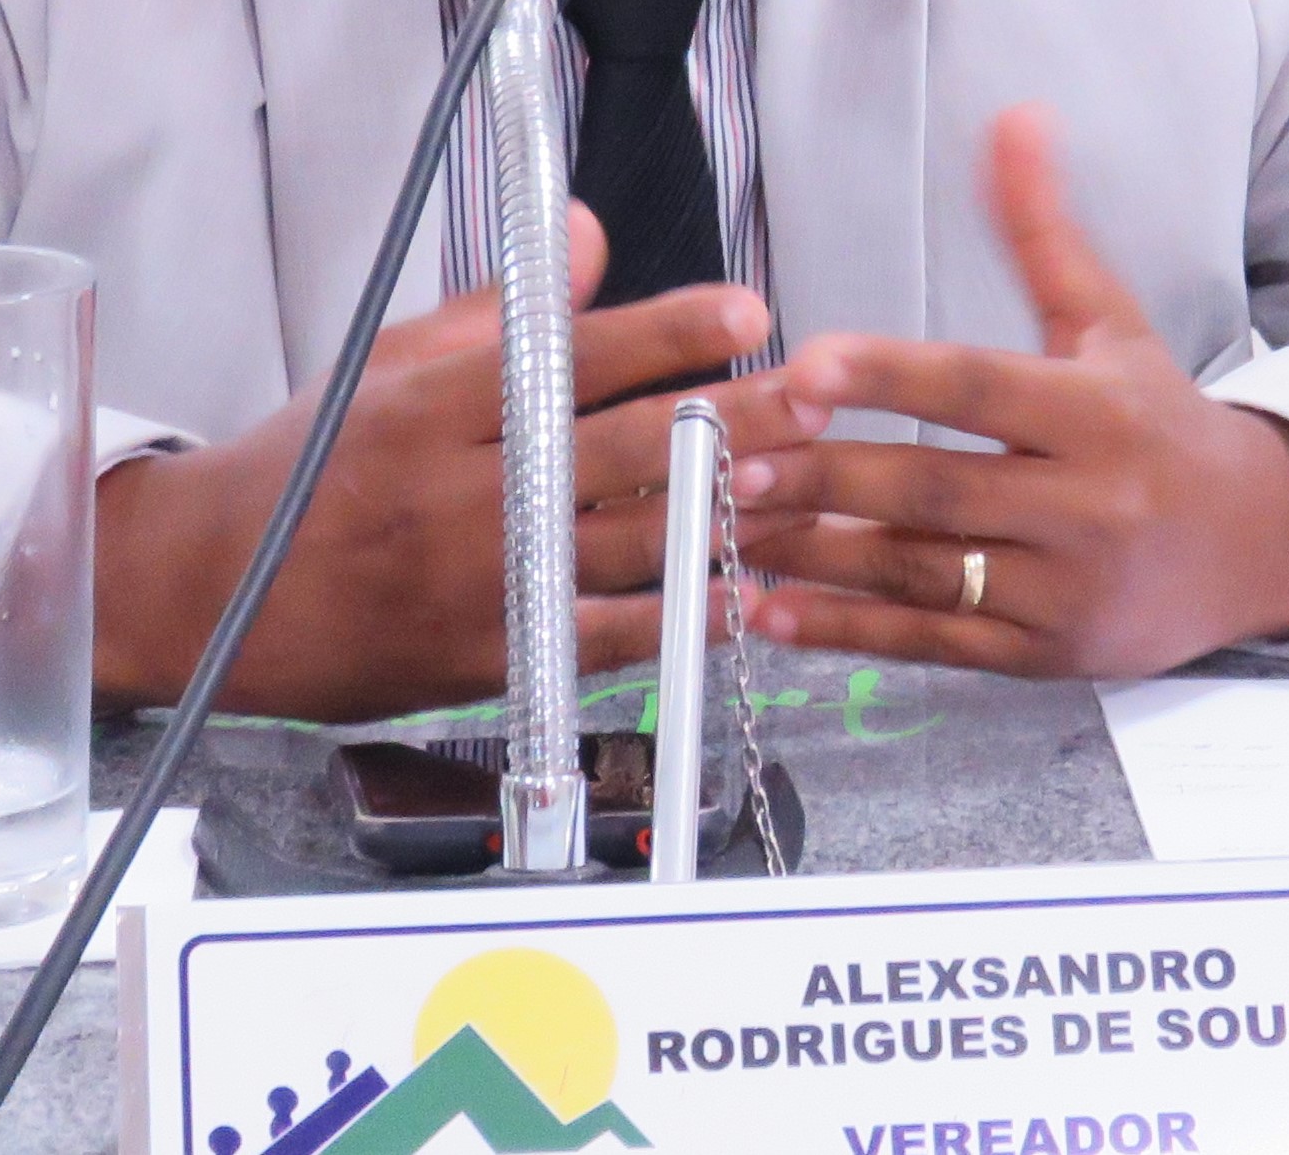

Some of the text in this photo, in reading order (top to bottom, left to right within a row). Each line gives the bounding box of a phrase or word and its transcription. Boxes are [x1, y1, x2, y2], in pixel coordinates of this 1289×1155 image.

[801, 947, 1237, 1008] ALEXSANDRO
[646, 1014, 1029, 1075] RODRIGUES
[1051, 1010, 1135, 1056] DE
[841, 1111, 1201, 1155] VEREADOR
